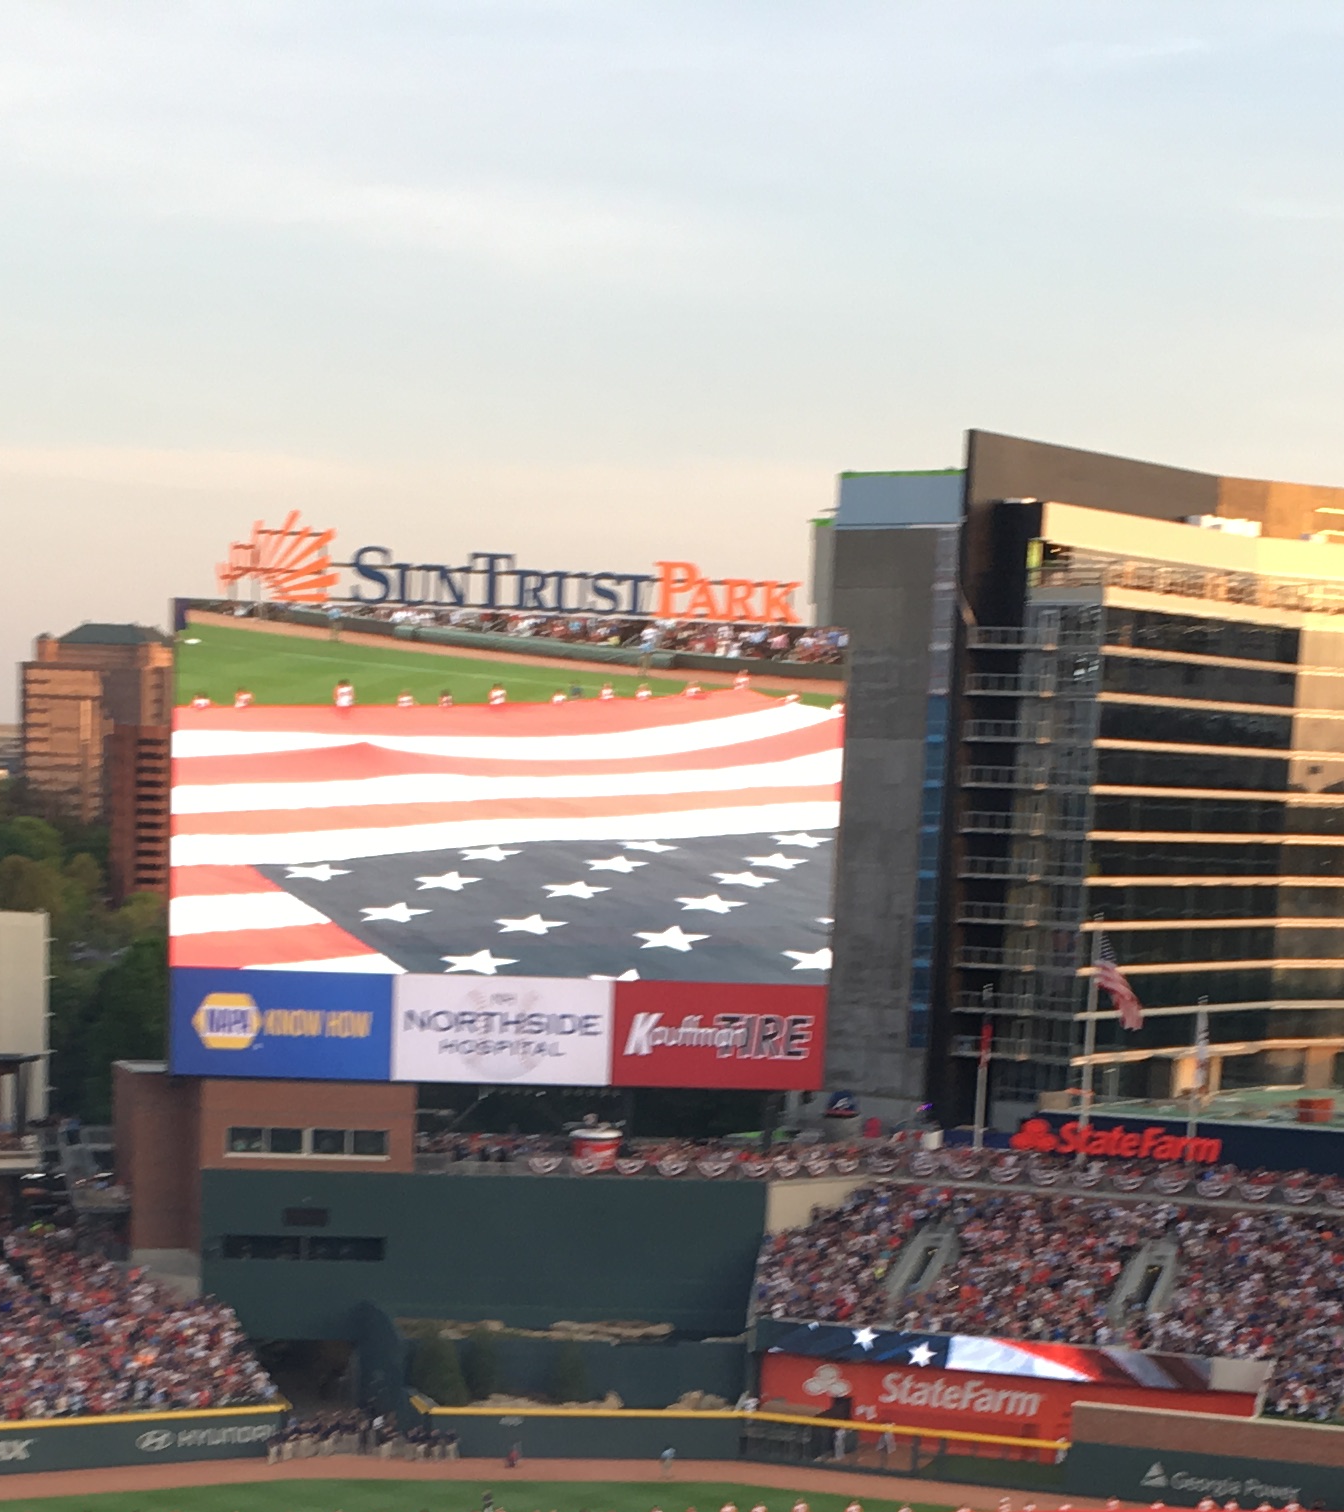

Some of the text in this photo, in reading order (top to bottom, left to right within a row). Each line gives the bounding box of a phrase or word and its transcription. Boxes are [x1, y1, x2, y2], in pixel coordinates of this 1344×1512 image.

[653, 560, 804, 624] PARK
[206, 1007, 374, 1038] NAPA KNOW HOW
[403, 1009, 604, 1037] NORTHSIDE
[623, 1012, 815, 1060] Kauffman TIRE
[438, 1038, 567, 1058] HOSPITAL
